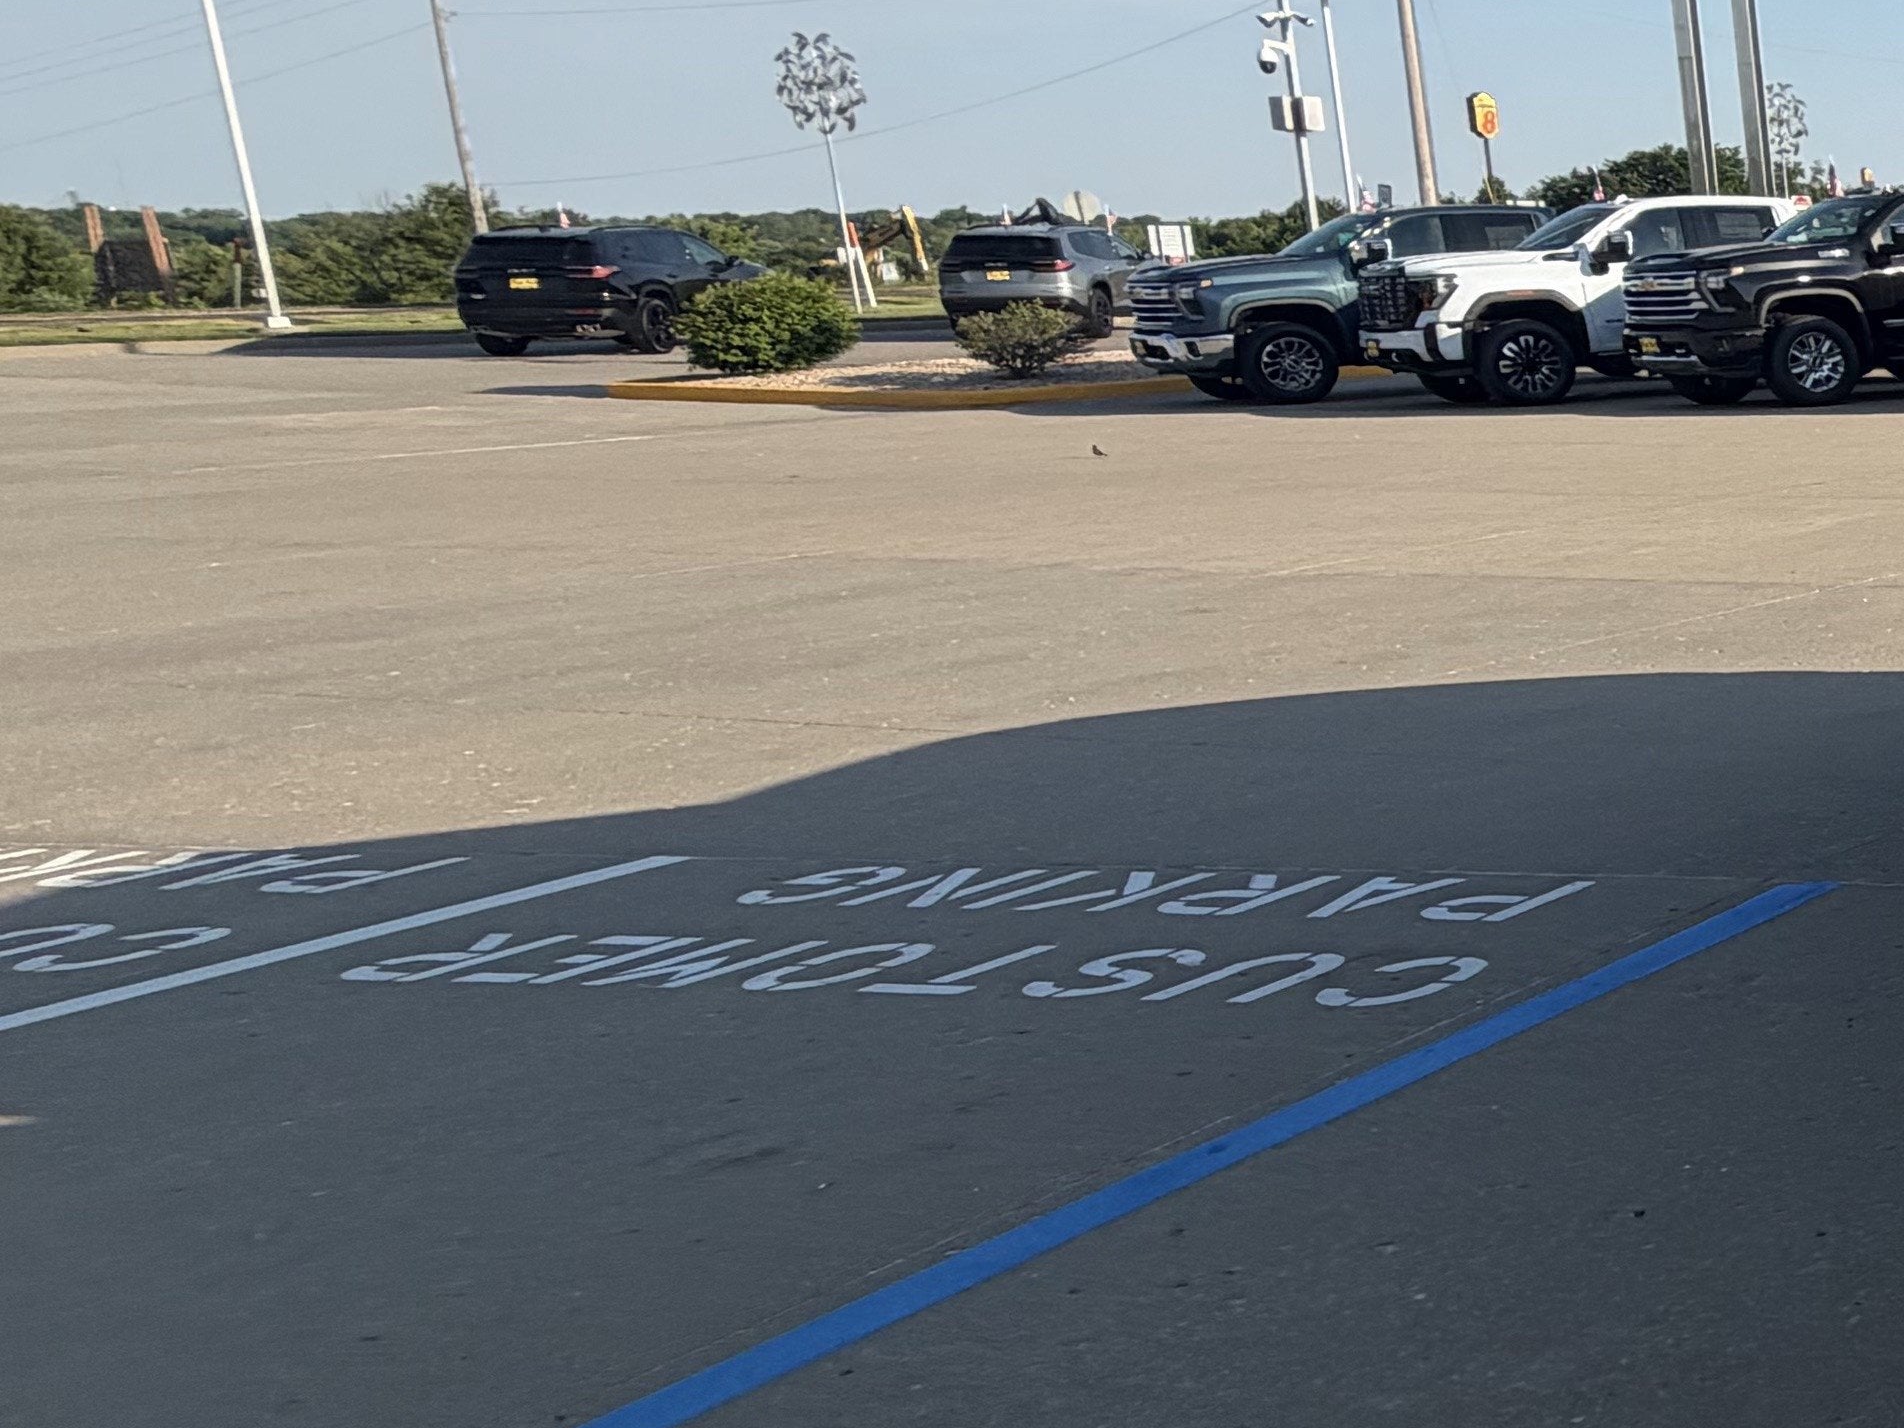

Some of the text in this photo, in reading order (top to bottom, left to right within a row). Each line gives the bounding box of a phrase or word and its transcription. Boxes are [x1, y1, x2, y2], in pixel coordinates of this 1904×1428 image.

[1482, 110, 1496, 134] 8
[736, 865, 1597, 922] PARKING
[340, 932, 1489, 1008] CUSTOMER
